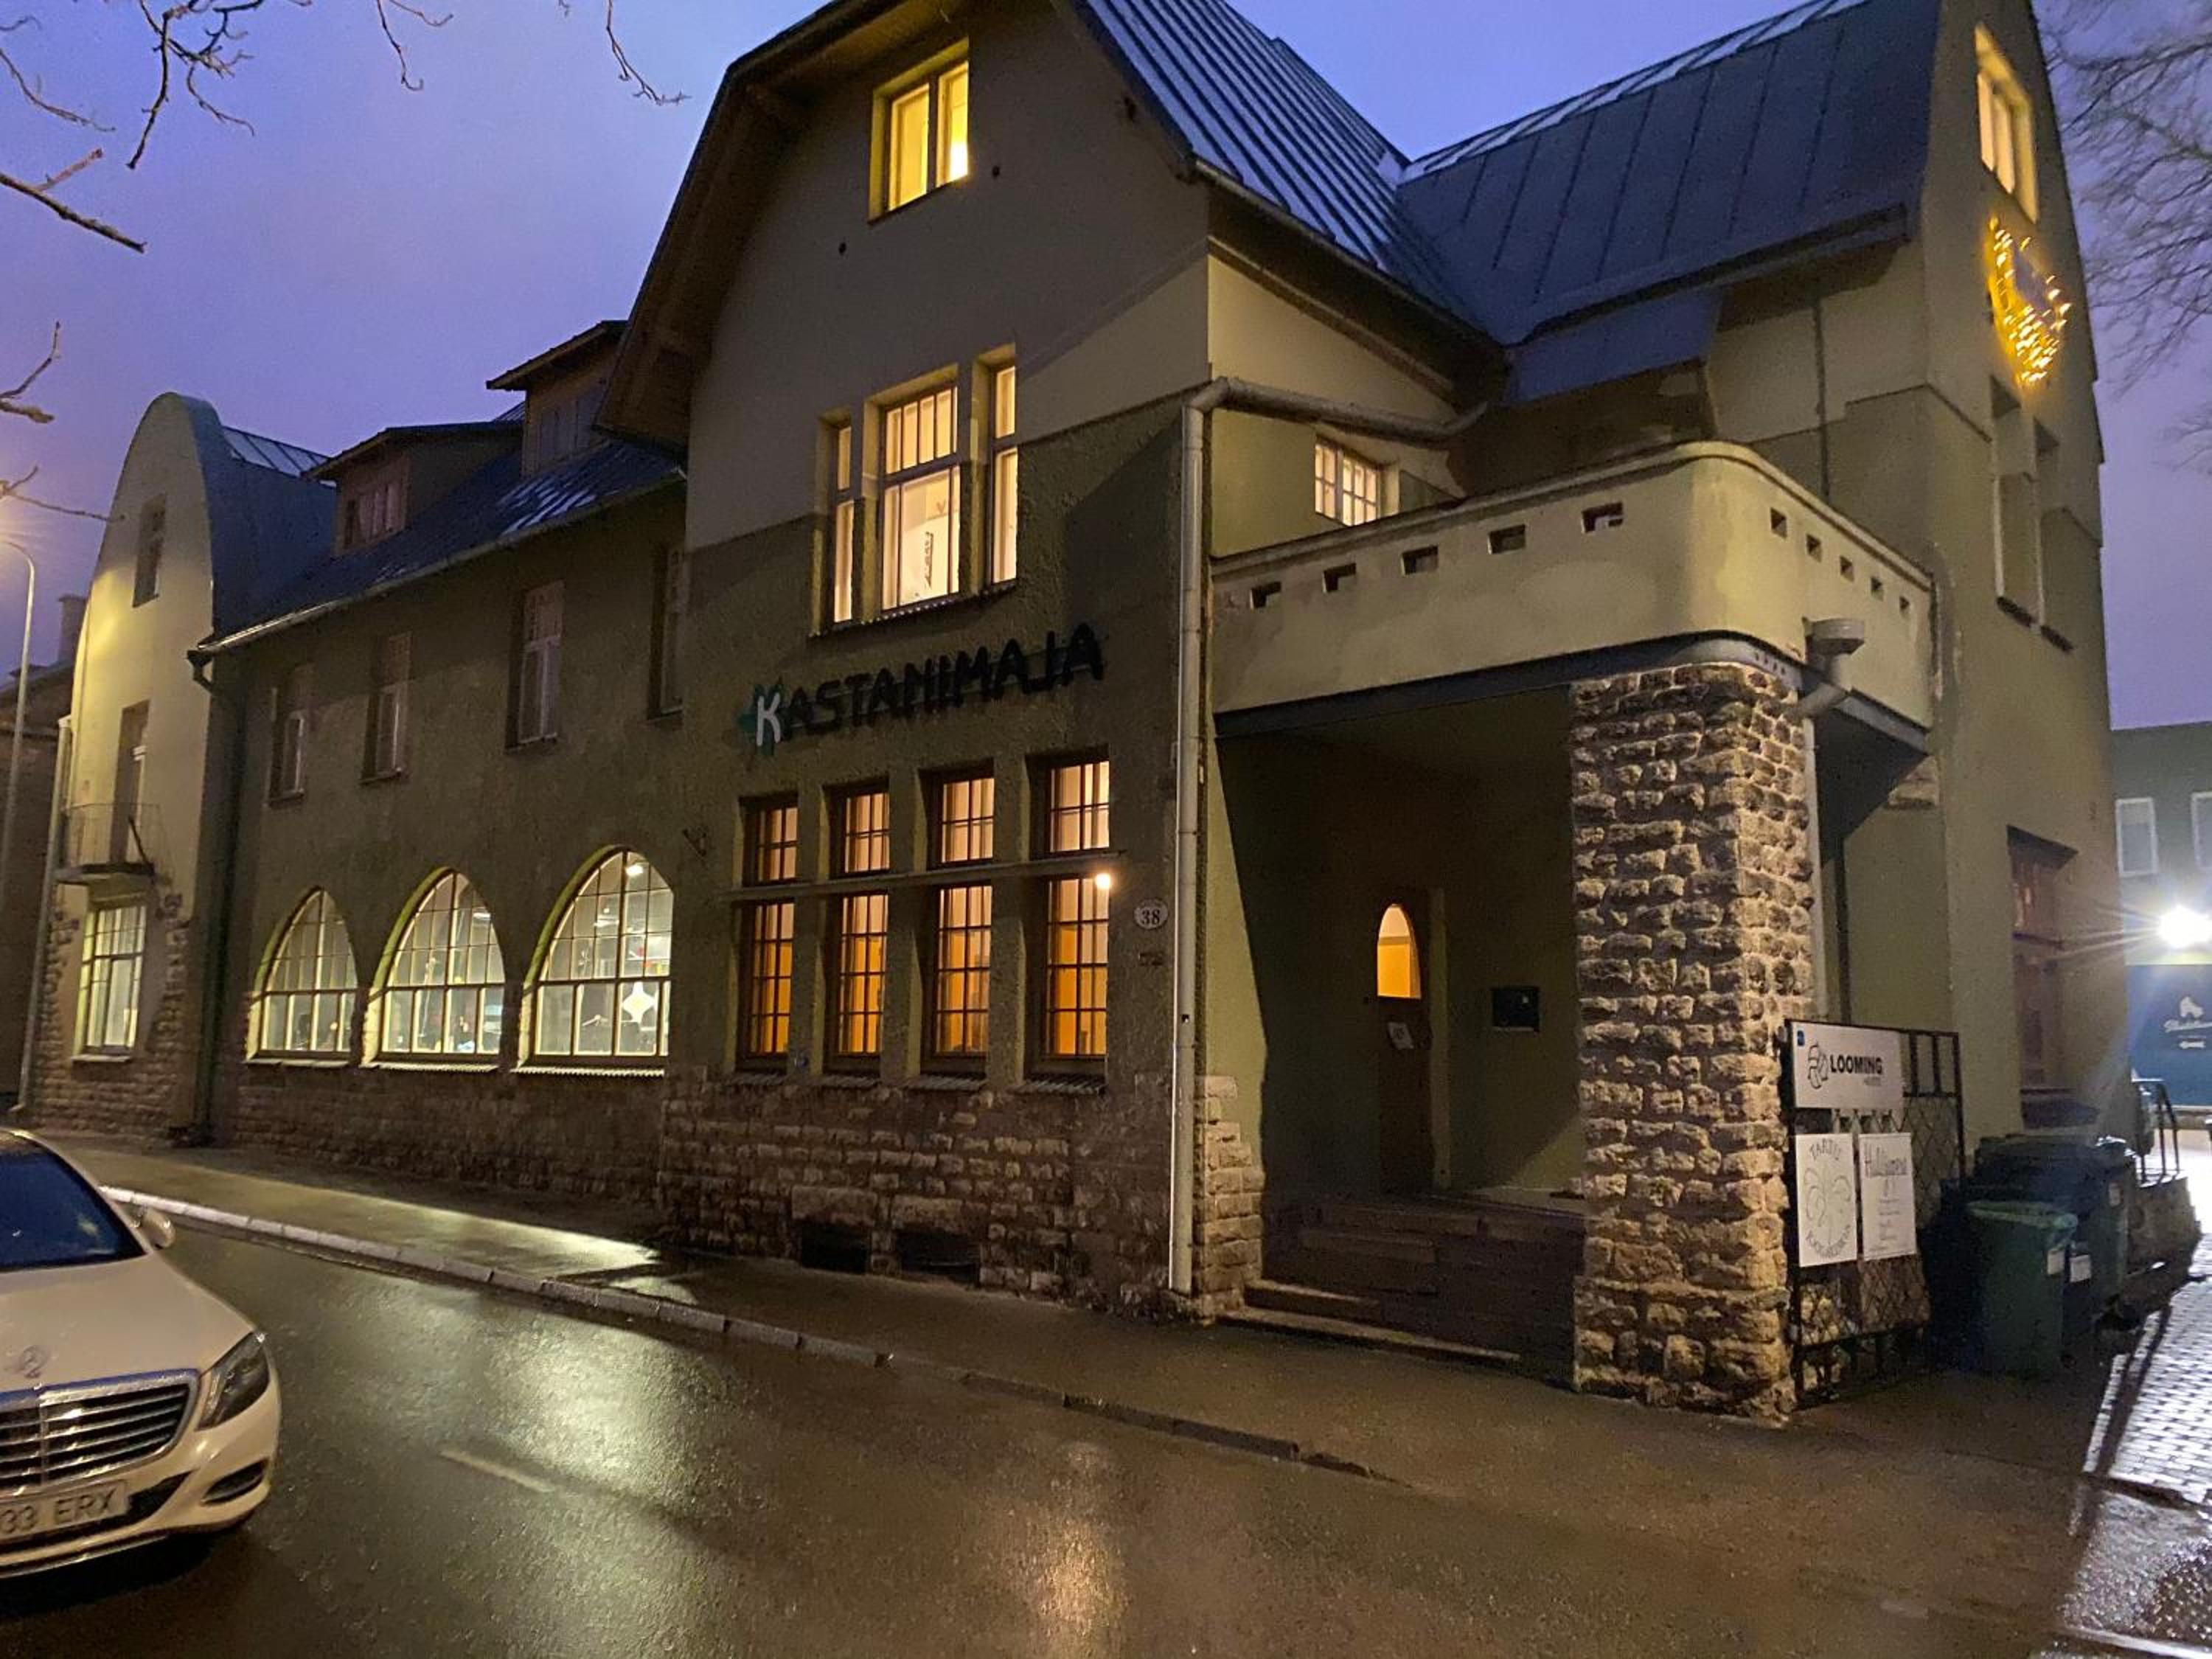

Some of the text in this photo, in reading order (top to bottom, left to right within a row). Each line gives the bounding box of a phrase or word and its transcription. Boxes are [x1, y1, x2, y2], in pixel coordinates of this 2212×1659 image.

[754, 622, 1105, 748] KASTANIMAJA
[1141, 909, 1161, 925] 38
[1829, 1054, 1883, 1074] LOOMING
[54, 1486, 118, 1526] ERX
